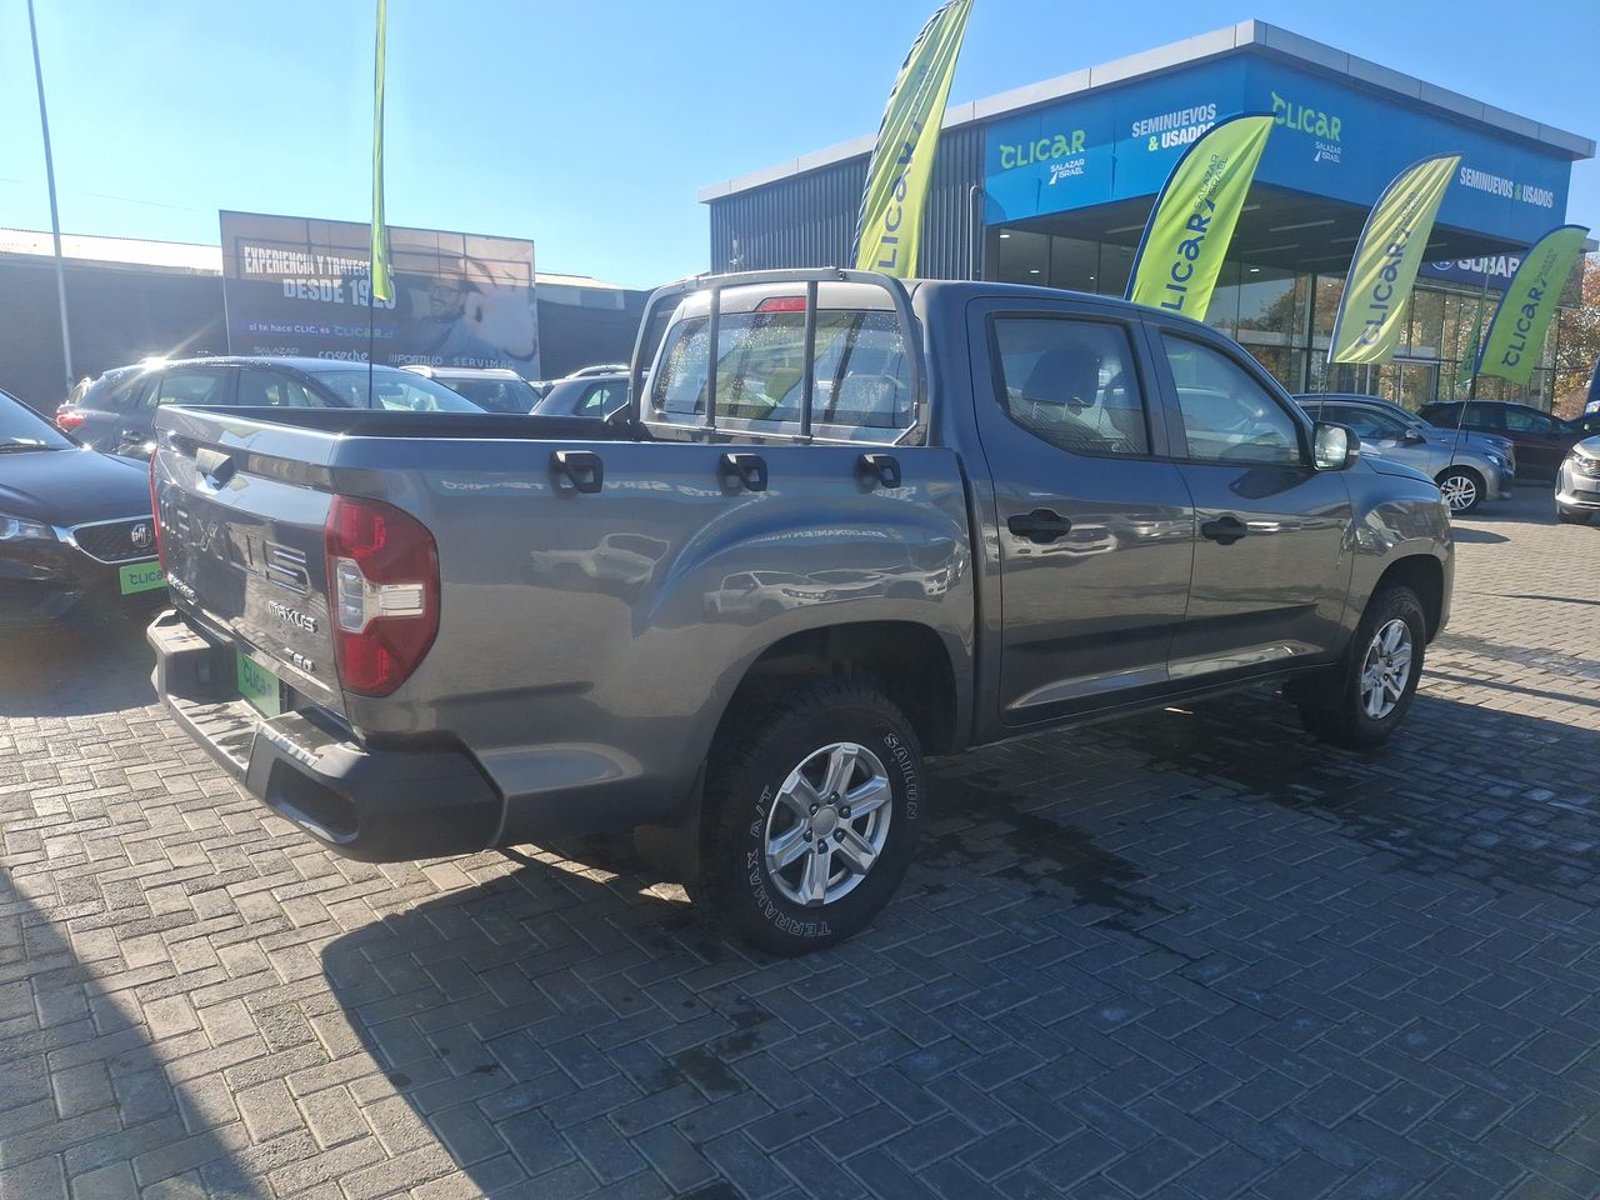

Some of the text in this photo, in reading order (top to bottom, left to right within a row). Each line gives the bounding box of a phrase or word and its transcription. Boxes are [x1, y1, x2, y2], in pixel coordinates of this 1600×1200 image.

[1131, 103, 1217, 138] SEMINUEVOS
[1148, 136, 1159, 151] &
[1315, 141, 1342, 154] SALAZAR
[1050, 158, 1085, 173] SALAZAR
[1058, 167, 1084, 179] ISRAEL
[1459, 166, 1514, 199] SEMINUEVOS
[1522, 184, 1553, 209] USADOS
[244, 246, 315, 276] EXPERIENCIA
[316, 255, 324, 275] Y
[283, 278, 345, 304] DESDE
[270, 323, 292, 333] hace
[317, 348, 370, 363] coseche
[268, 600, 318, 634] MAXUS
